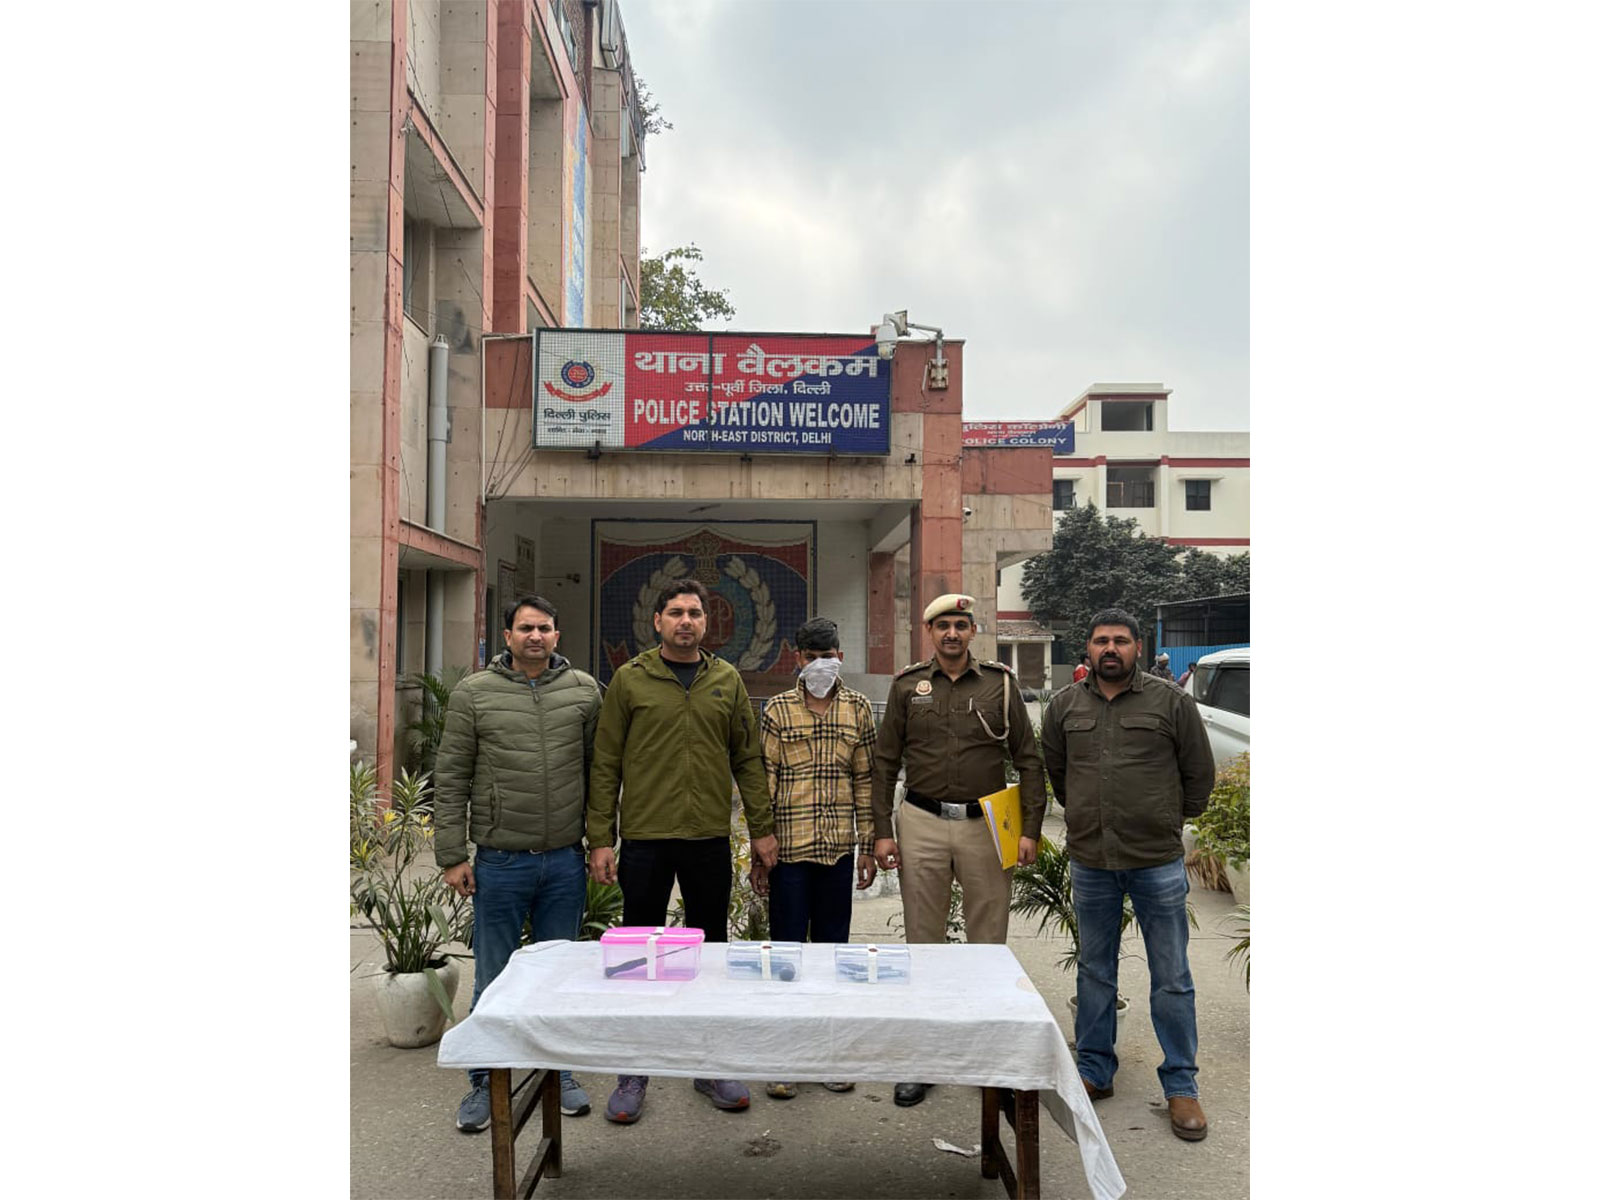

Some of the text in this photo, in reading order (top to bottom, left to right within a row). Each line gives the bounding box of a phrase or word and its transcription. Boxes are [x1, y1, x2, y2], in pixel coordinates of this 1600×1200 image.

[634, 343, 881, 378] थाना वैलकम
[793, 381, 831, 395] दिल्ली
[544, 408, 611, 422] दिल्ली पुलिस
[634, 399, 880, 429] POLICE STATION WELCOME
[751, 431, 800, 445] DISTRICT,
[802, 432, 832, 444] DELHI
